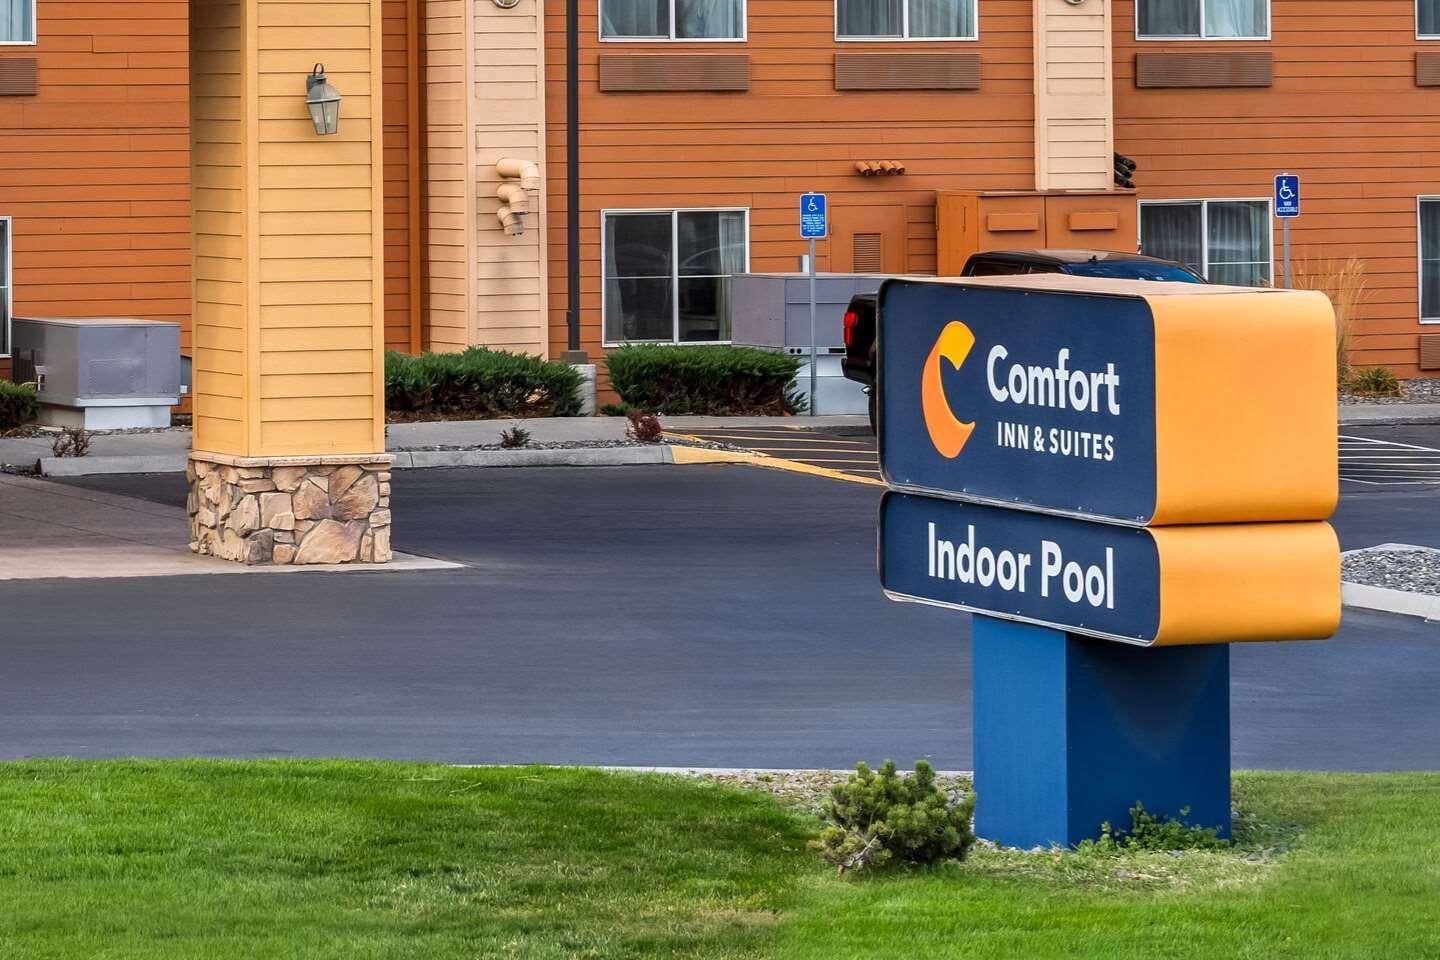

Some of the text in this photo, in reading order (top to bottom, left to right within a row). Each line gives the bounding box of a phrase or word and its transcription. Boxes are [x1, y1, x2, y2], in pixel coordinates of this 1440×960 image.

[986, 344, 1121, 416] Comfort
[996, 421, 1115, 462] INN & SUITES
[928, 521, 1115, 610] Indoor Pool
